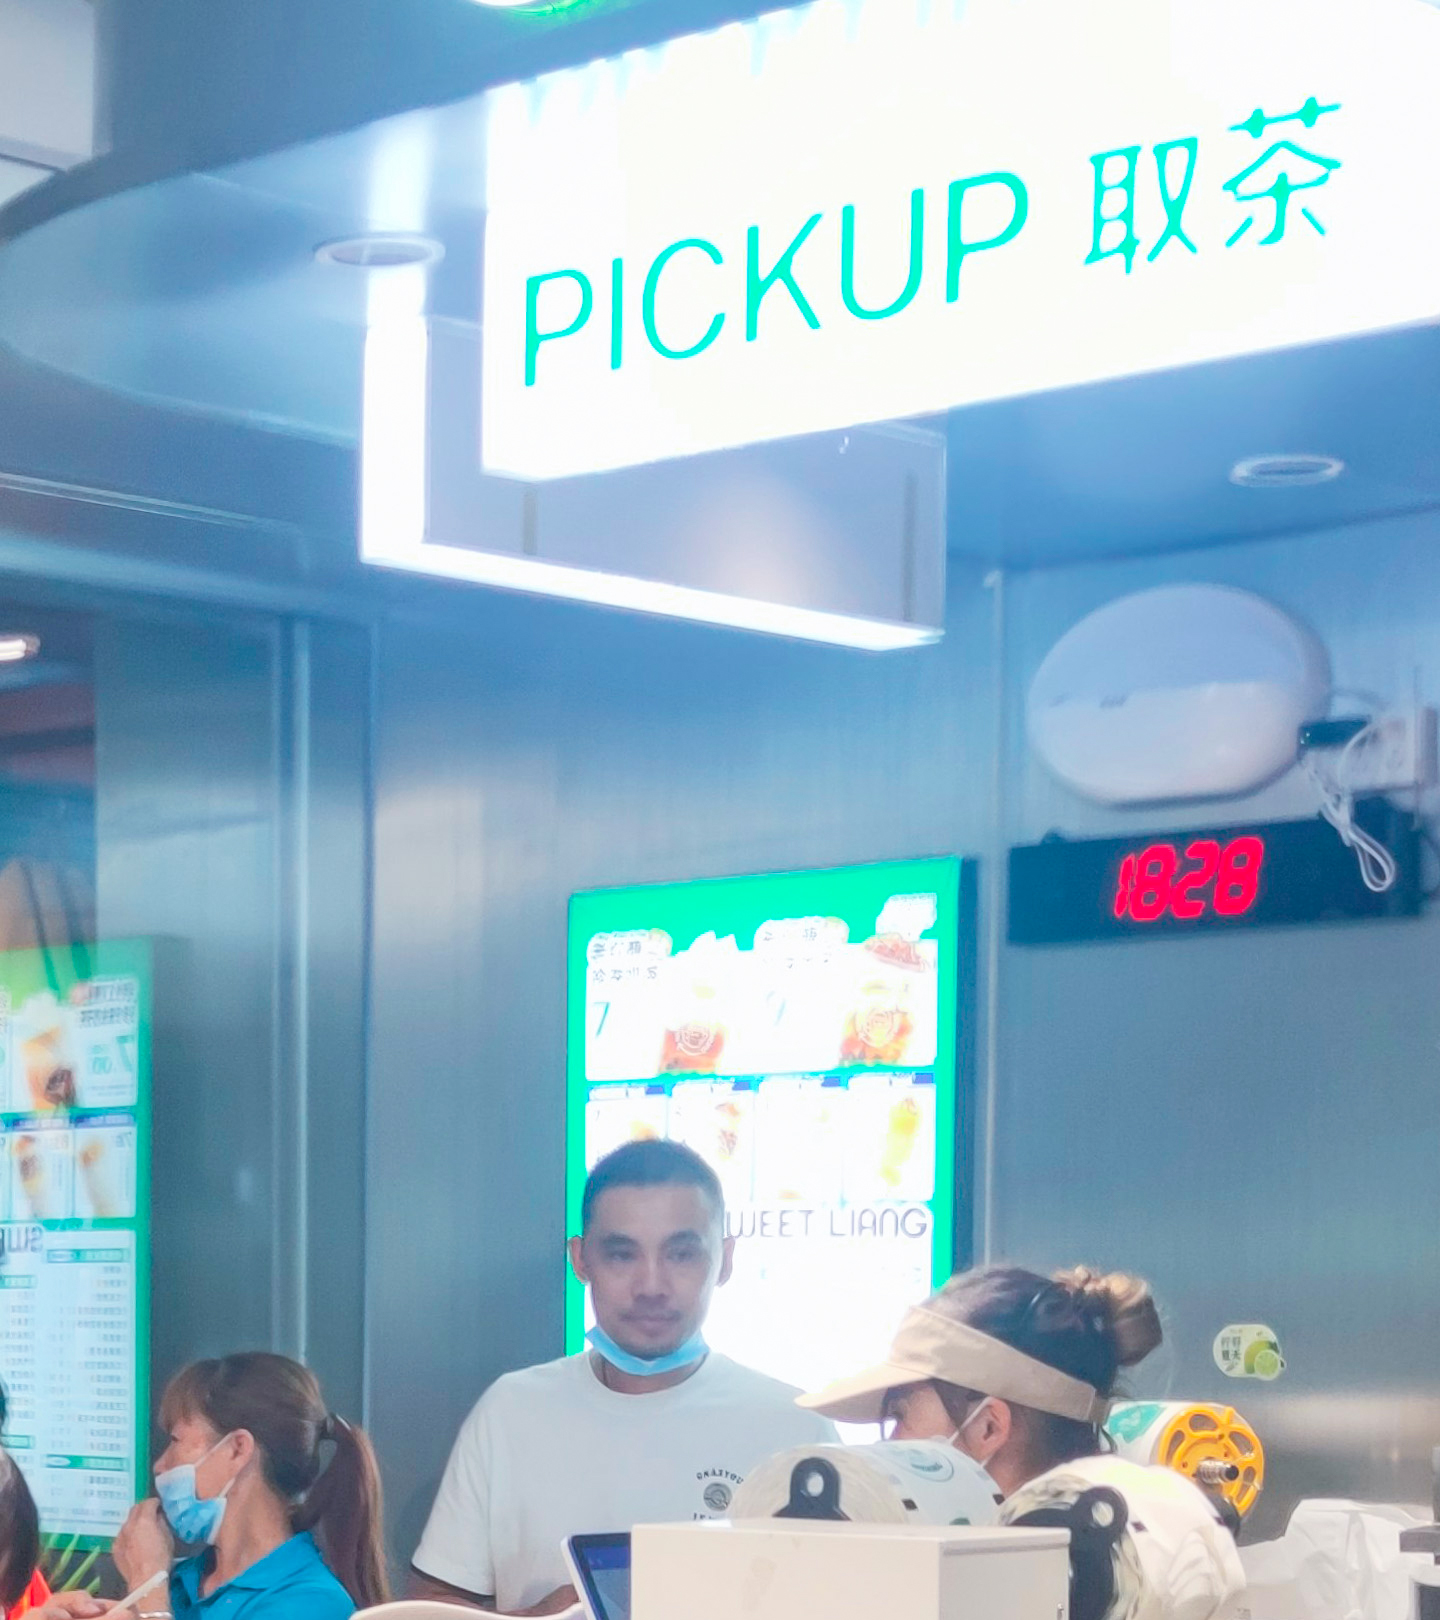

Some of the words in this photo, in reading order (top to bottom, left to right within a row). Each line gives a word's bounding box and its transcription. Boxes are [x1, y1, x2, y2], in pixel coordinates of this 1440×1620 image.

[524, 172, 1029, 388] PICKUP
[1084, 97, 1342, 276] 取茶
[1114, 837, 1264, 921] 1828
[829, 1206, 928, 1239] LIANG
